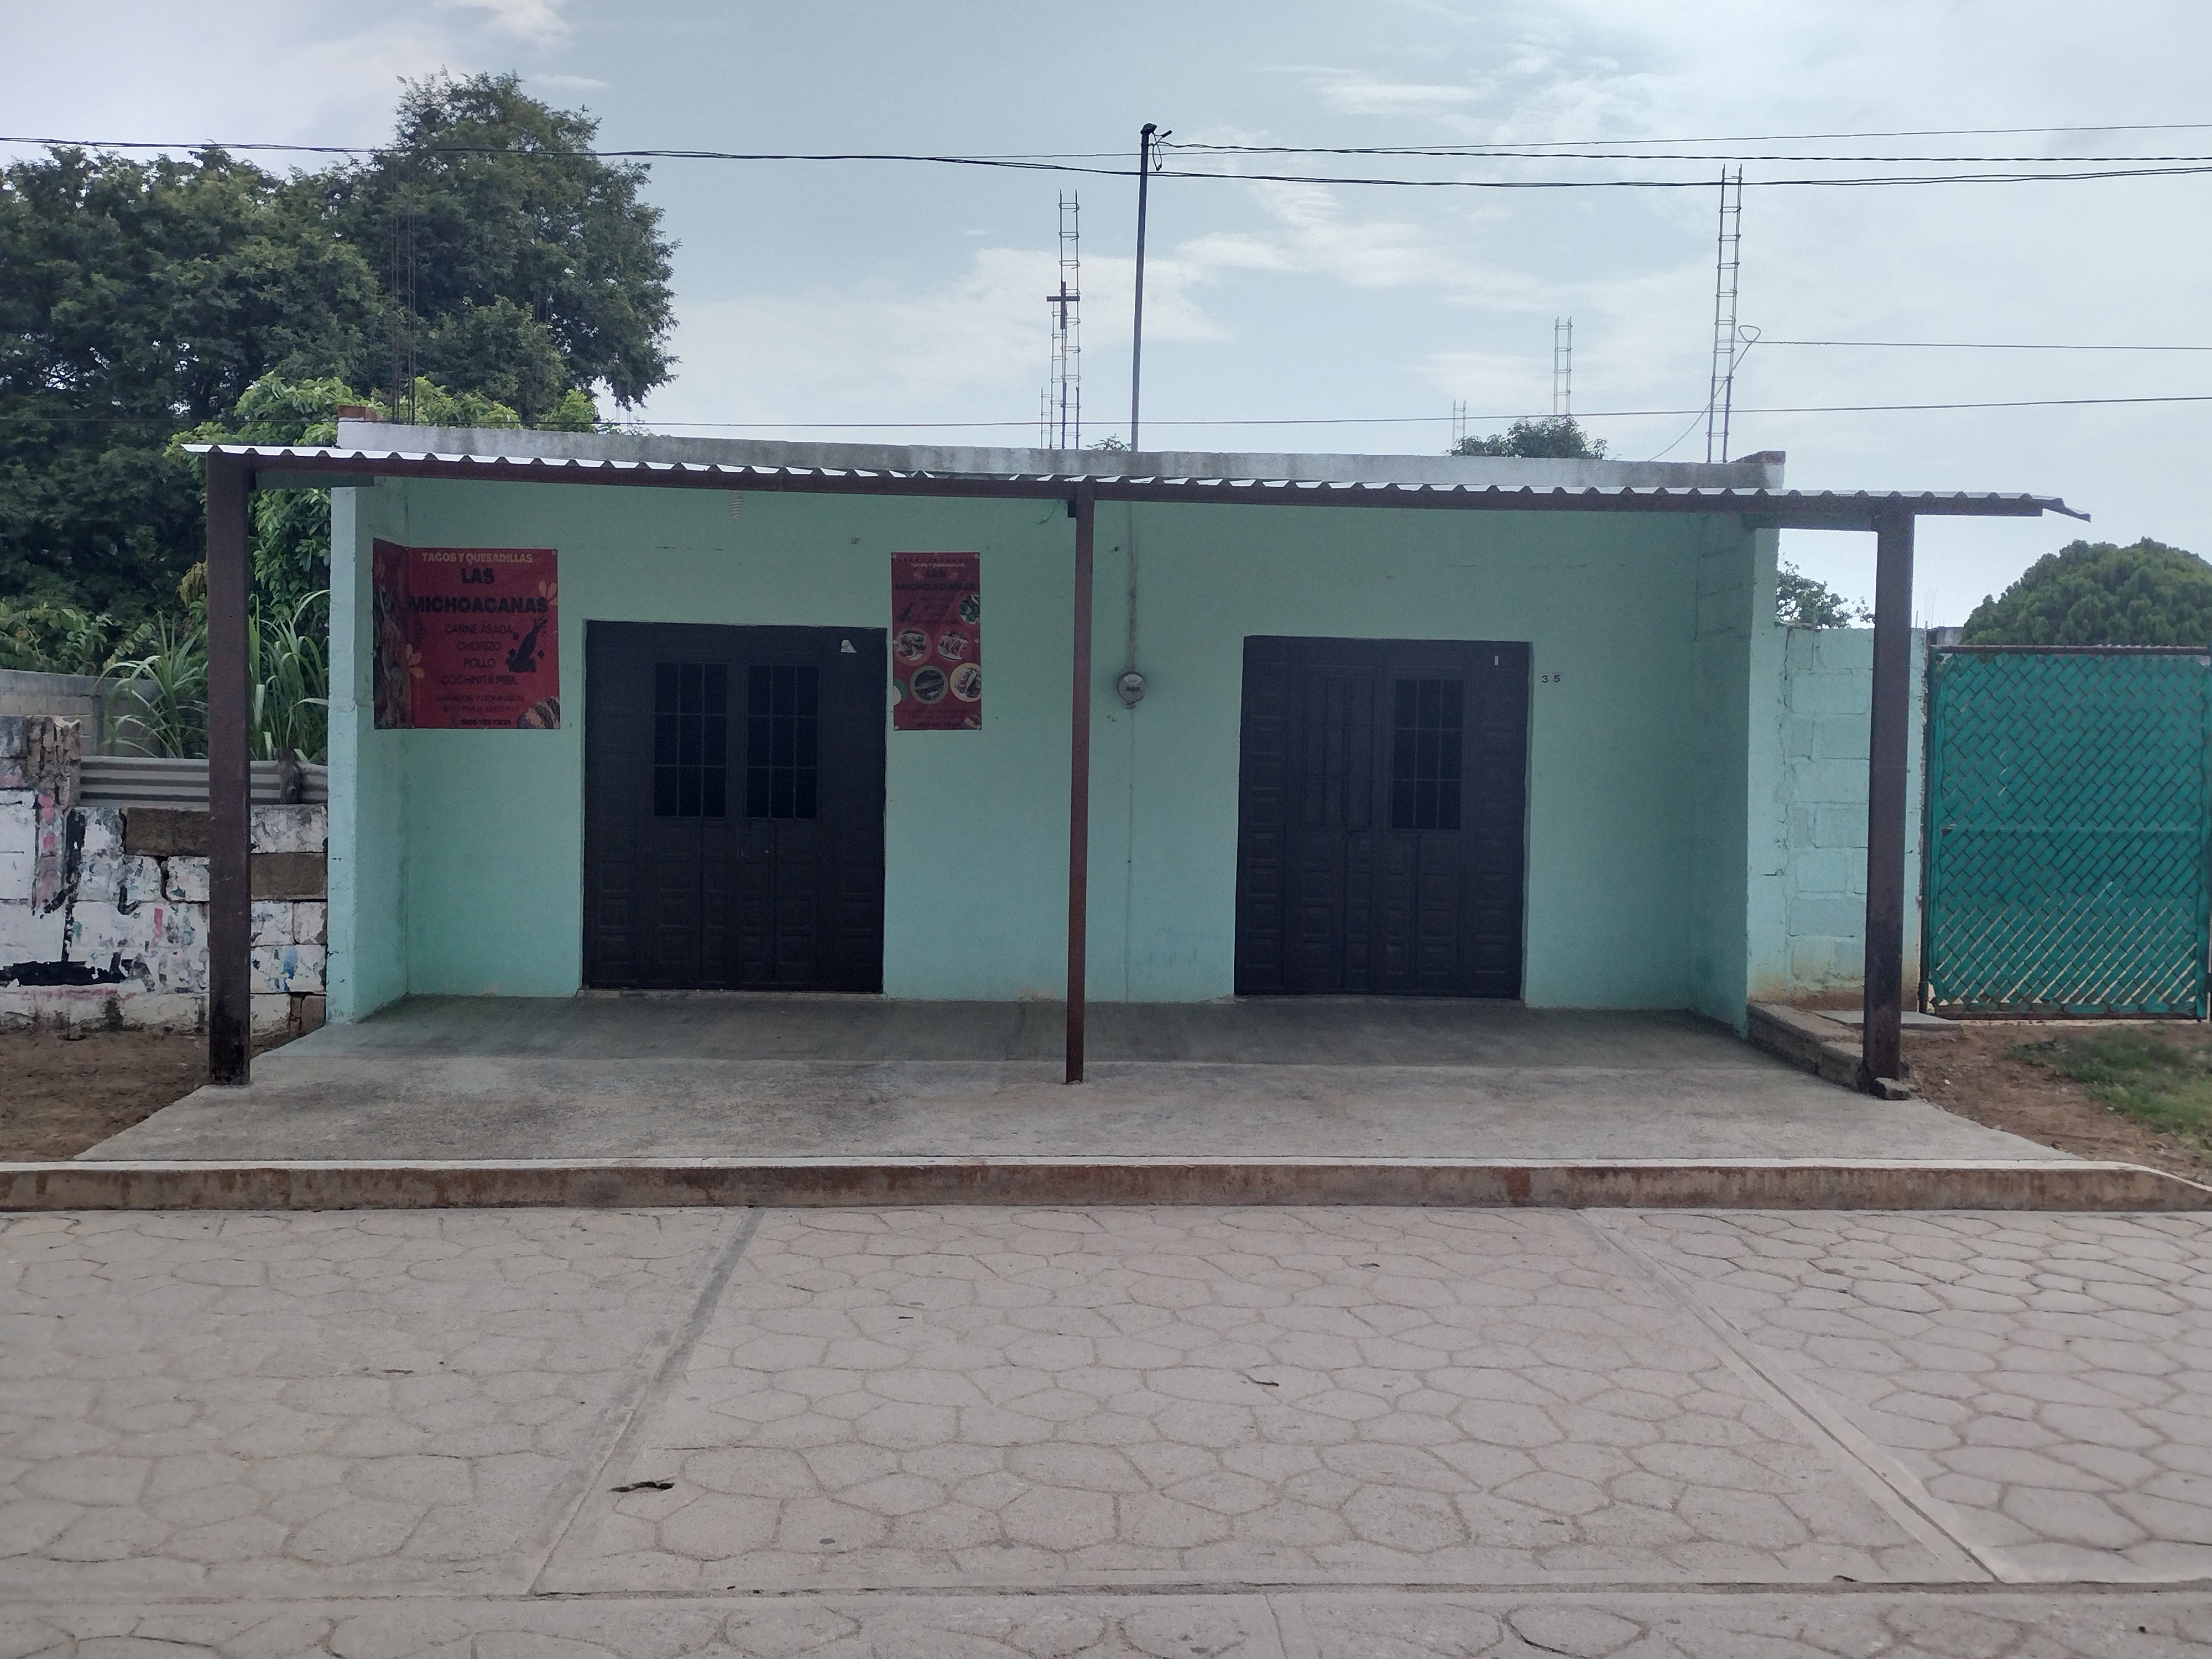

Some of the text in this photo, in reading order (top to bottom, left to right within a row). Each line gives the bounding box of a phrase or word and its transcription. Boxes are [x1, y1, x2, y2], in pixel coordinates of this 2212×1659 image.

[422, 552, 533, 565] TACOS Y QUESADILLAS
[460, 567, 495, 584] LAS
[406, 596, 549, 613] MICHOACANAS
[445, 624, 514, 634] CARNE ASADA
[456, 641, 502, 651] CHORIZO
[463, 658, 495, 668] POLLO
[440, 674, 518, 685] COCHINITA PIBIL
